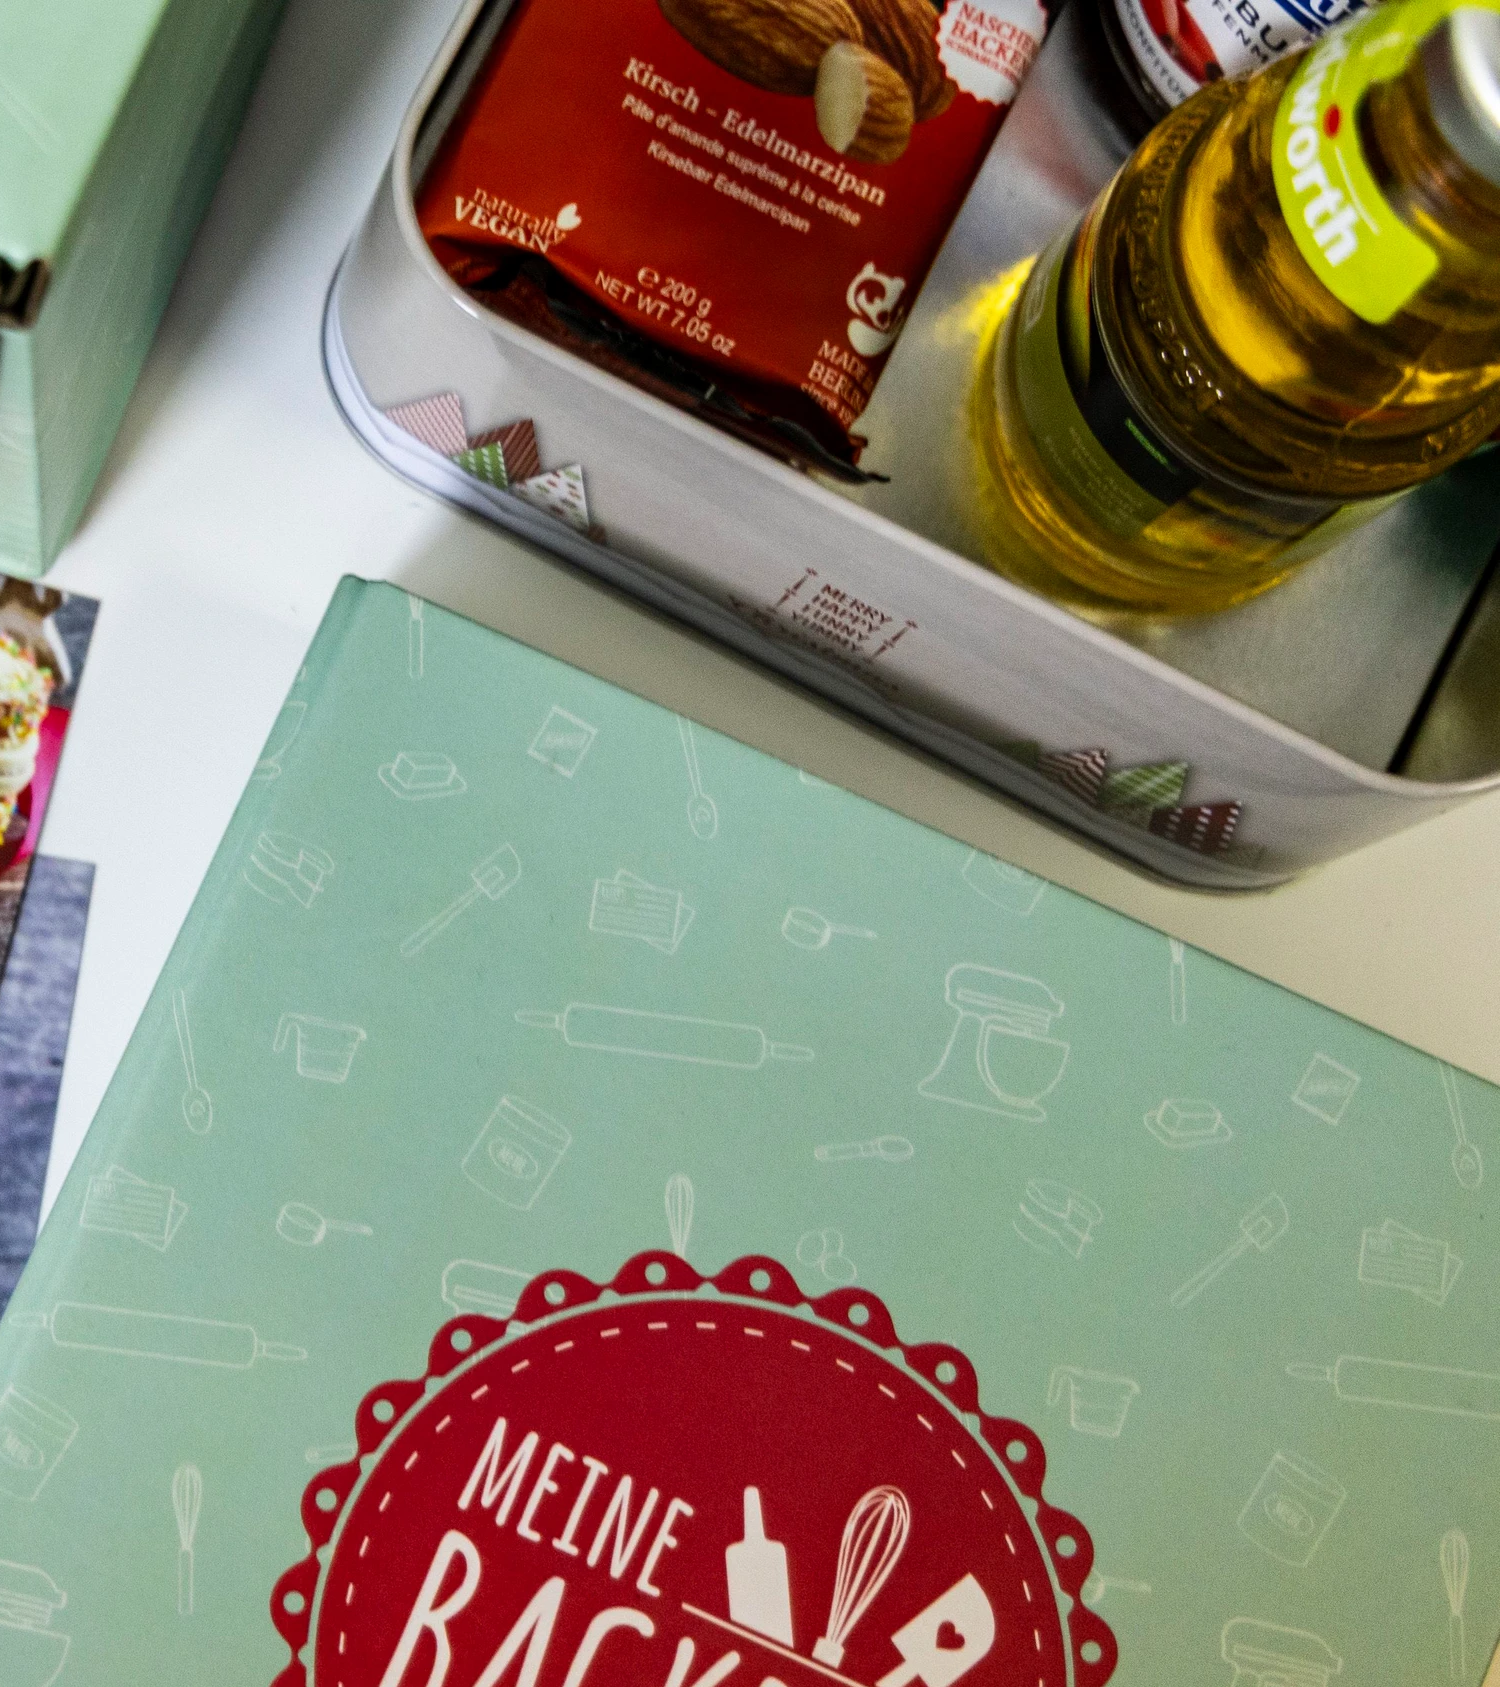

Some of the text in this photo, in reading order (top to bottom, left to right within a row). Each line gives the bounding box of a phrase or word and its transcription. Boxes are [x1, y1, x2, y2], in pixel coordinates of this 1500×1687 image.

[622, 56, 700, 114] Kirsch
[720, 107, 886, 207] Edelmarzipan
[1286, 35, 1358, 268] worth
[454, 195, 551, 255] VEGAN
[473, 186, 566, 246] naturally
[801, 184, 816, 205] la
[816, 195, 861, 228] cerise
[594, 269, 736, 358] NET WT 7.05 oz
[660, 275, 698, 308] 200
[697, 297, 712, 320] g
[457, 1417, 695, 1597] MEINE
